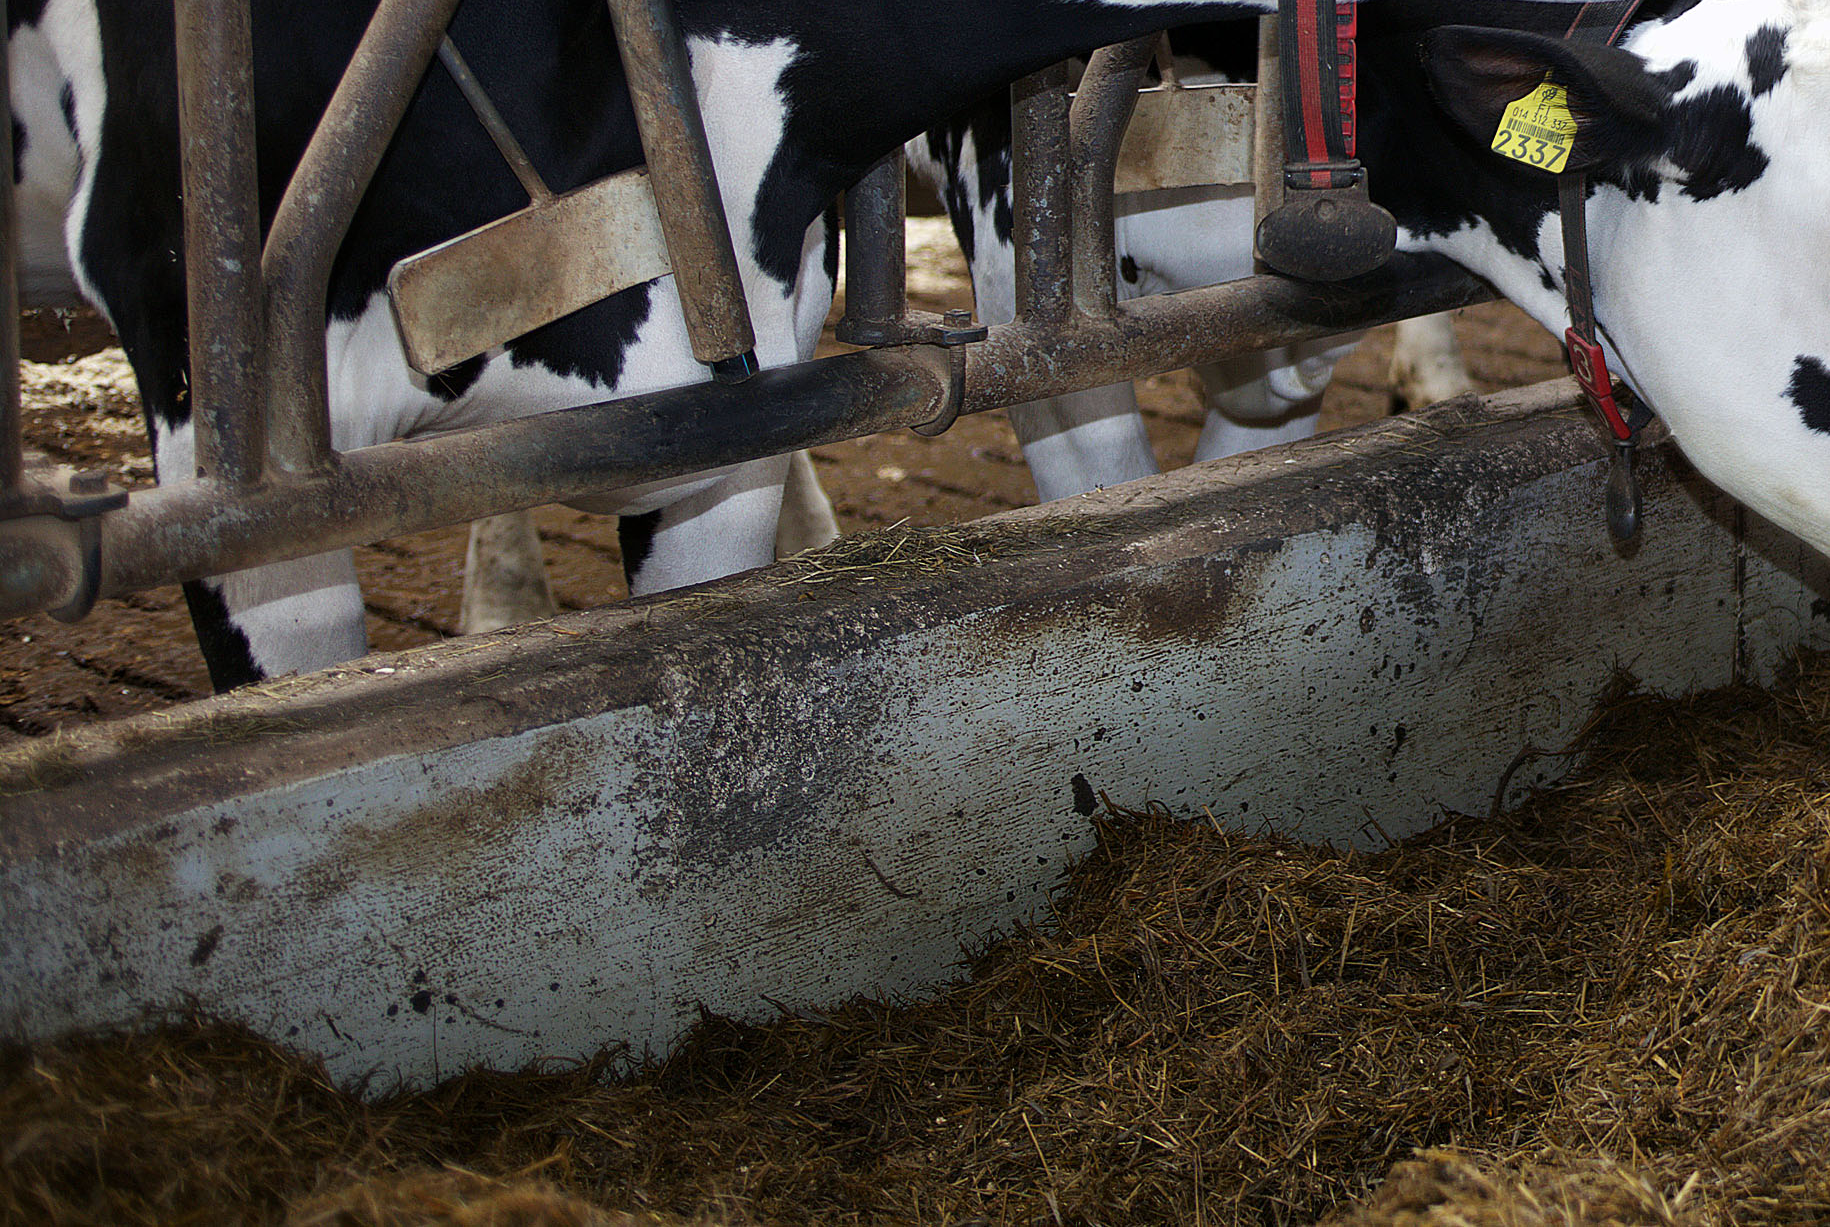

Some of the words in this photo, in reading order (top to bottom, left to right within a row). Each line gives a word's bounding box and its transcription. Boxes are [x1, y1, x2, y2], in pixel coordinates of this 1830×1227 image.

[1512, 107, 1529, 119] 014
[1531, 113, 1548, 127] 312
[1550, 119, 1567, 131] 337
[1493, 130, 1566, 169] 2337
